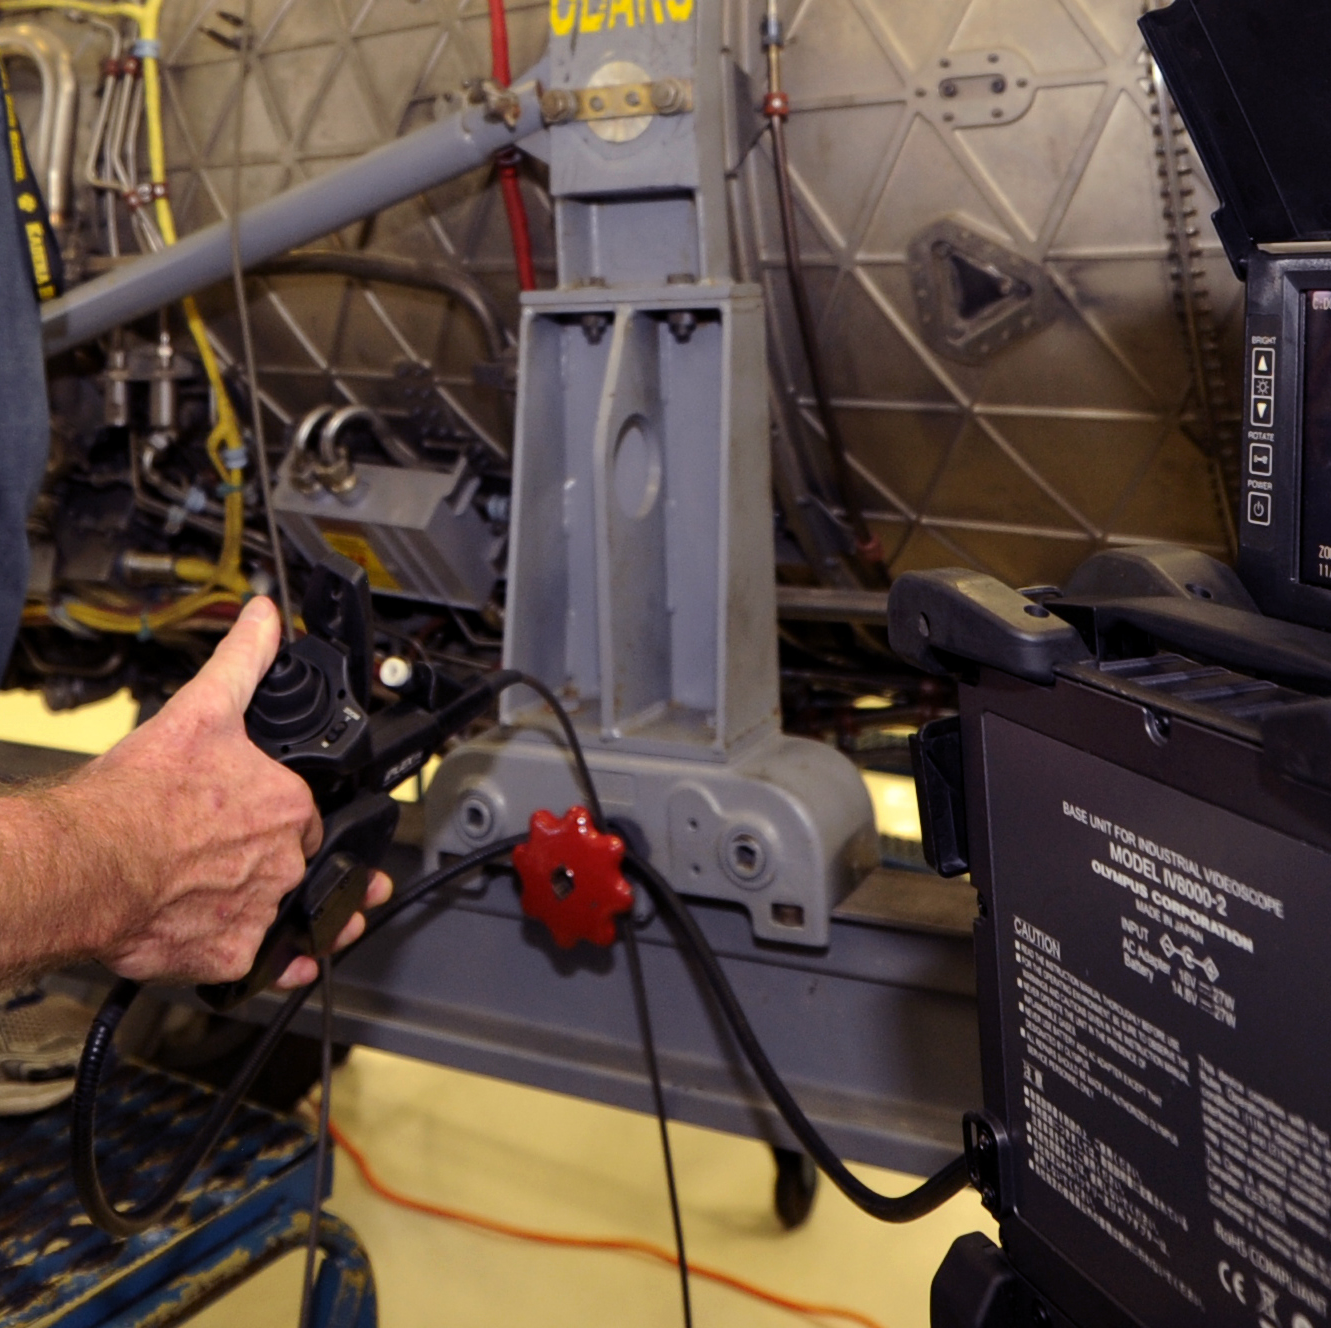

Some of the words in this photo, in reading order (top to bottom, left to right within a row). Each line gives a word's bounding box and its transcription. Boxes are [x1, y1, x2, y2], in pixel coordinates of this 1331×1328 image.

[1251, 336, 1276, 345] BRIGHT
[1248, 431, 1275, 442] ROTATE
[1247, 479, 1273, 491] POWER
[1062, 800, 1088, 825] BASE
[1089, 814, 1112, 835] UNIT
[1114, 825, 1137, 847] FOR
[1138, 837, 1202, 880] INDUSTRIAL
[1202, 867, 1285, 919] VIDEOSCOPE
[1109, 841, 1161, 884] MODEL
[1162, 867, 1228, 917] IV8000-2
[1091, 859, 1148, 898] OLYMPUS
[1151, 889, 1254, 954] CORPORATION
[1135, 898, 1161, 923] MADE
[1013, 917, 1061, 960] CAUTION
[1121, 916, 1149, 943] INPUT
[1123, 936, 1136, 955] AC
